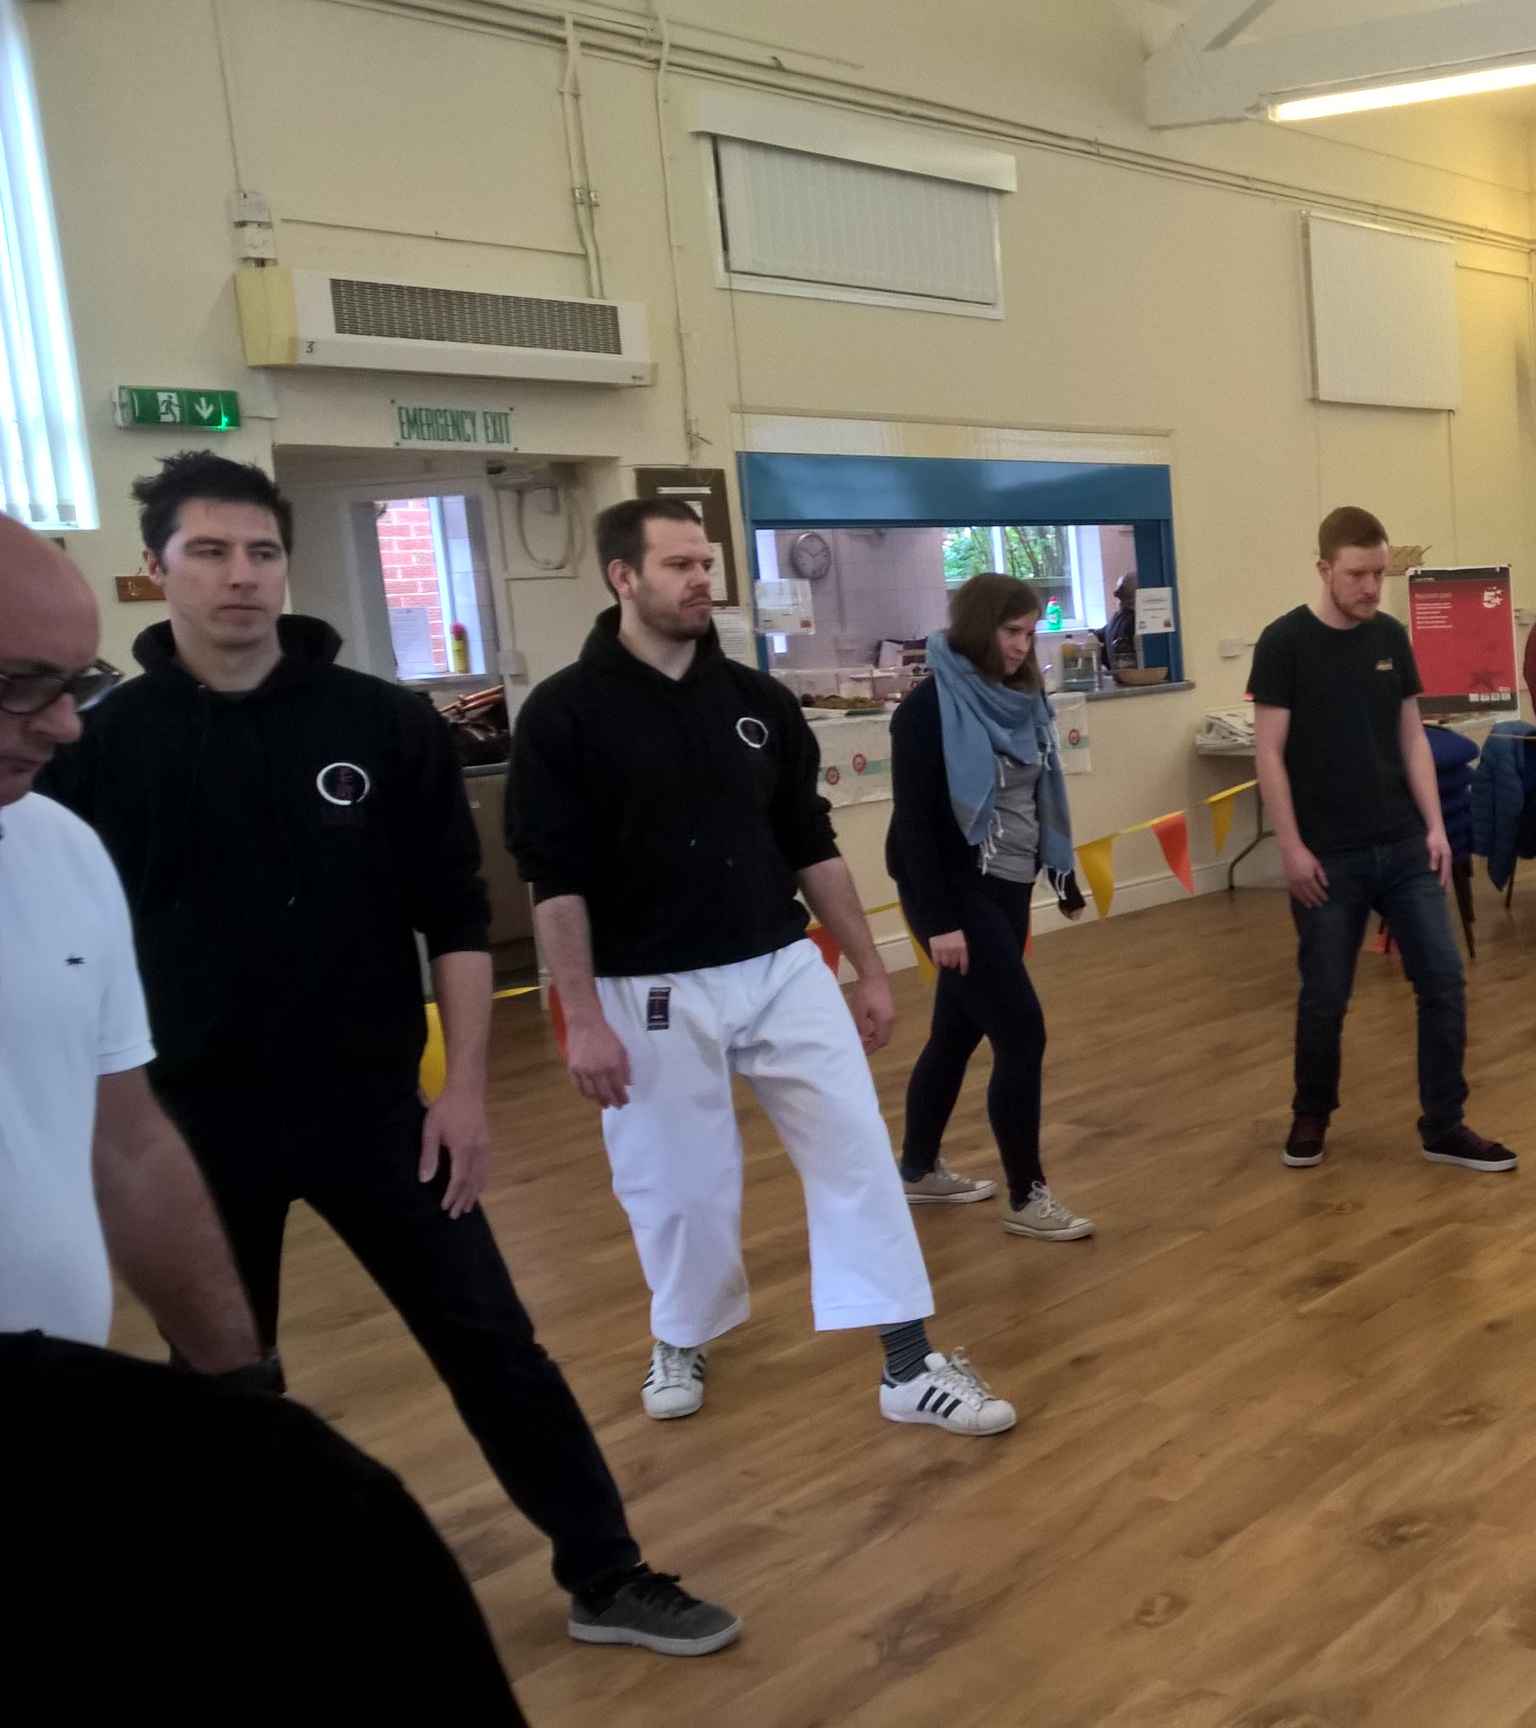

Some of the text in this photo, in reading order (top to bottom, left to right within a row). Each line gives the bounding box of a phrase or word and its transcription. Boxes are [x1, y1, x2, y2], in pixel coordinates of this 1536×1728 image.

[306, 341, 314, 353] 3
[397, 406, 510, 444] EMERGENCY EXIT
